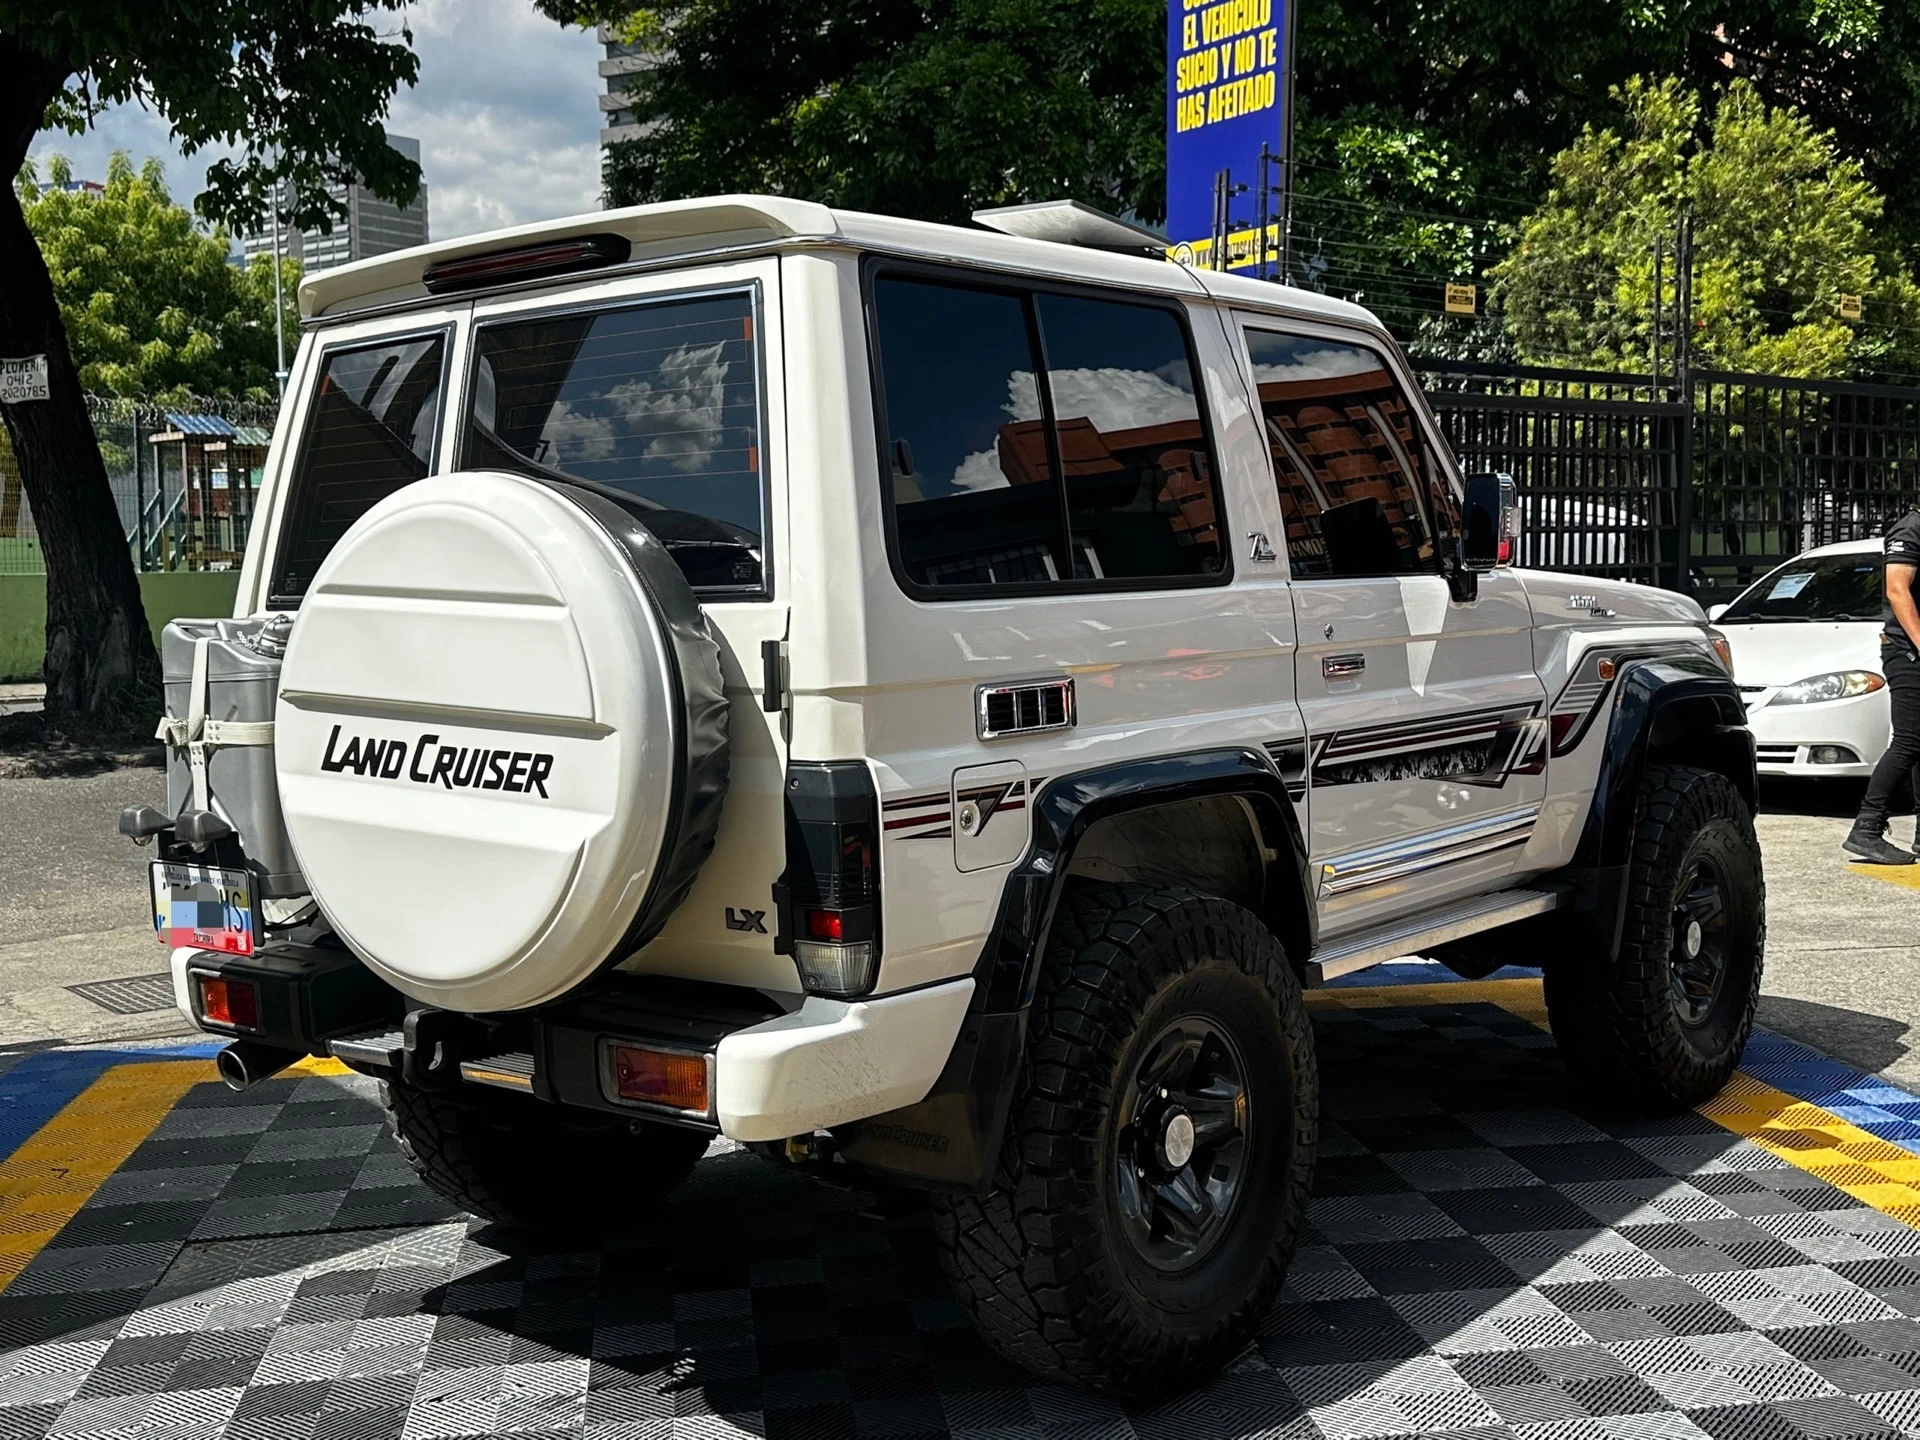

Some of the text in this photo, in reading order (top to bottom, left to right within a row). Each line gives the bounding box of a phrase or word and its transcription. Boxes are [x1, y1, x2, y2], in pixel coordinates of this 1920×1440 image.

[1183, 13, 1199, 51] EL
[1177, 28, 1277, 93] SUCIO Y NO TE
[1177, 71, 1276, 133] HAS AFEITADO
[2, 385, 47, 400] 2020785
[7, 374, 33, 386] 0412
[321, 725, 554, 799] LAND CRUISER
[725, 907, 768, 934] LX
